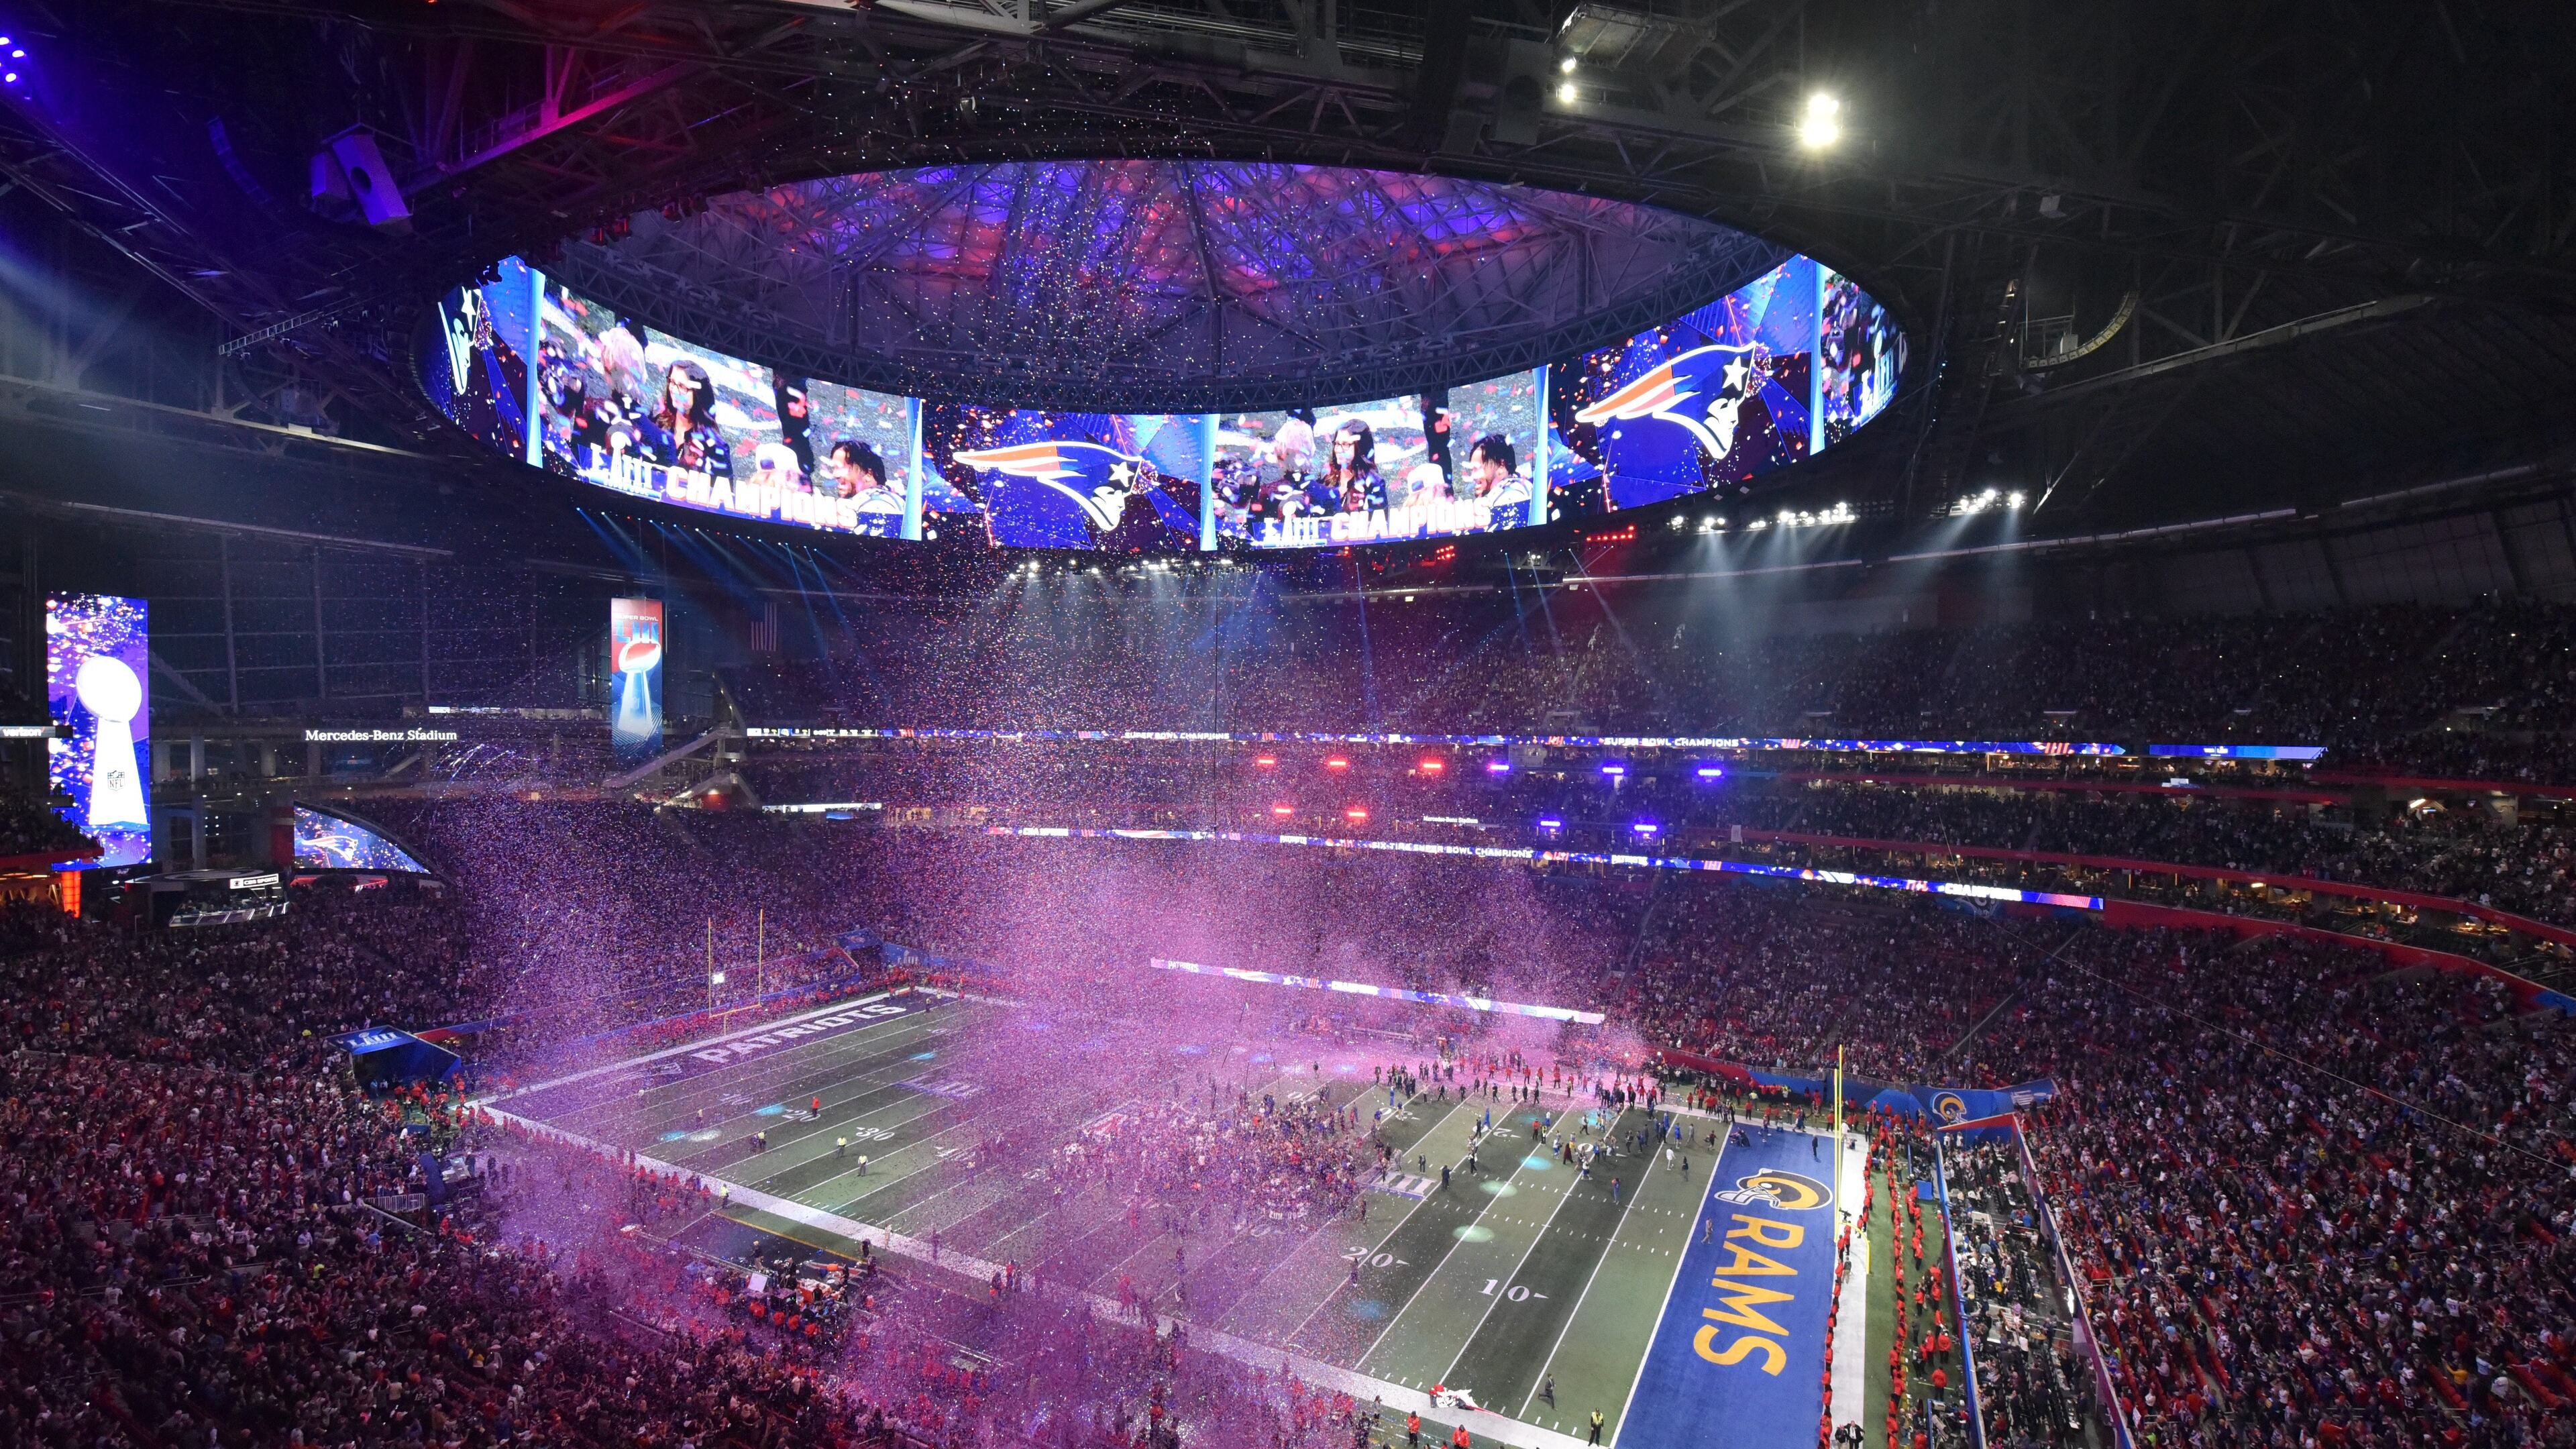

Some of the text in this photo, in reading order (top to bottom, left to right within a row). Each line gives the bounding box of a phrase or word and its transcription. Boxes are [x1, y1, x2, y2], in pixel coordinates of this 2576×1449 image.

[666, 466, 858, 529] CHAMPIONS
[1330, 497, 1491, 541] CHAMPIONS
[3, 727, 41, 737] verizon
[305, 729, 458, 741] Mercedes-Benz Stadium
[1604, 738, 1739, 747] SUPER BOWL CHAMPIONS
[109, 779, 124, 788] NFL
[1446, 845, 1473, 855] BOWL
[1475, 847, 1534, 859] CHAMPIONS
[1168, 961, 1199, 973] PATRIOTS
[690, 1004, 907, 1063] PATRIOTS
[855, 1127, 895, 1141] 30
[1341, 1246, 1394, 1268] 20
[1478, 1279, 1530, 1302] 10
[1693, 1214, 1805, 1377] RAMS
